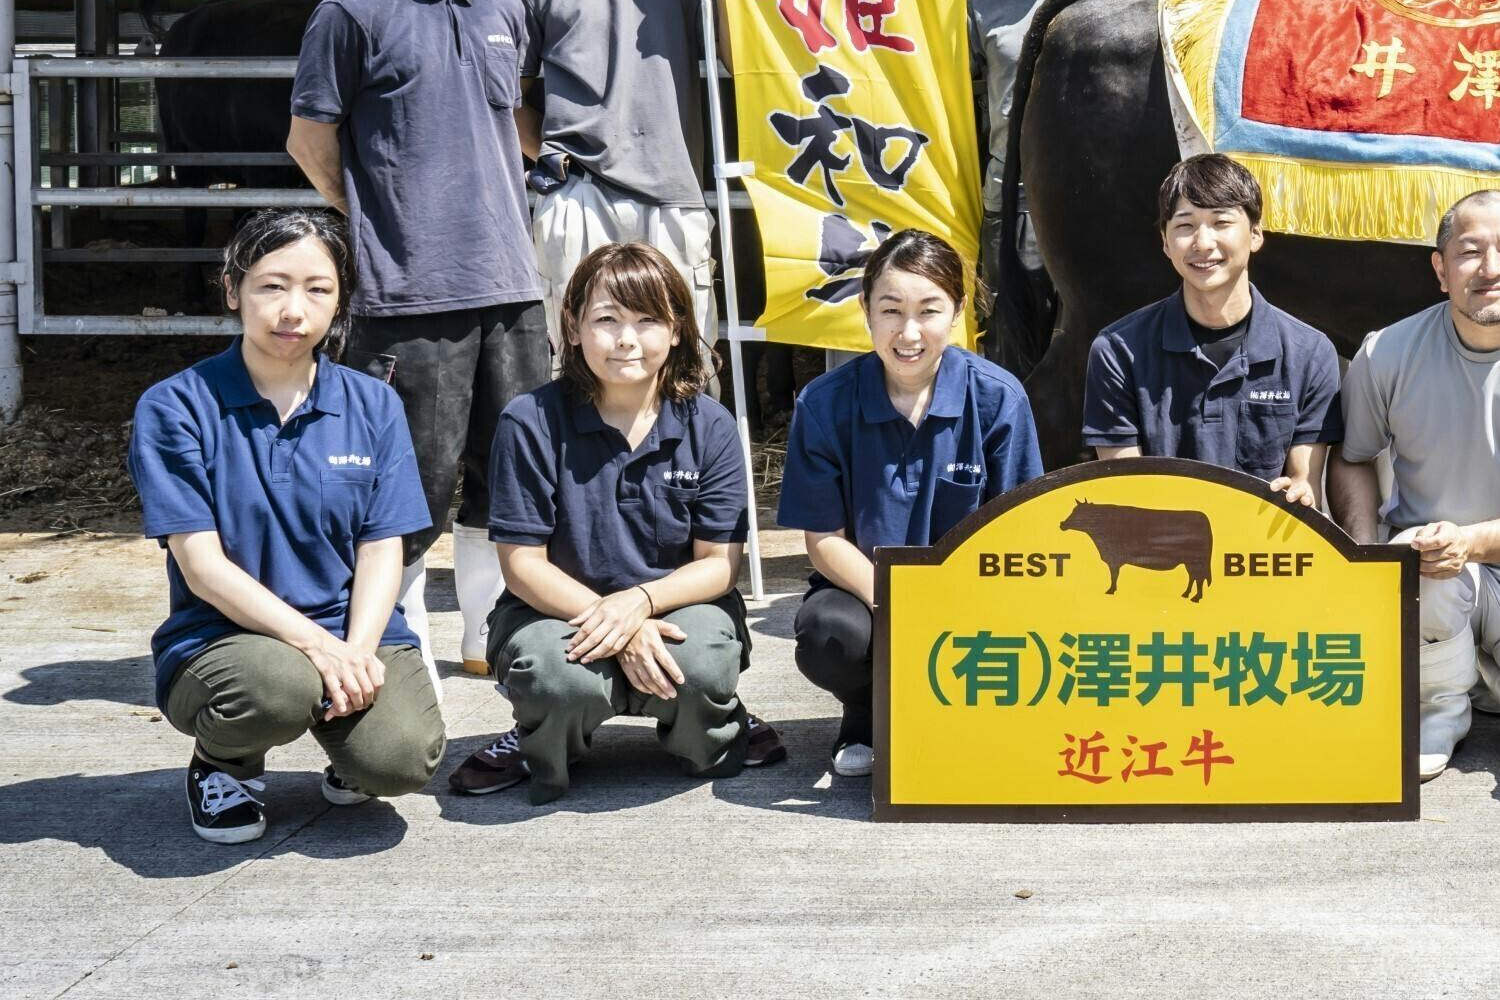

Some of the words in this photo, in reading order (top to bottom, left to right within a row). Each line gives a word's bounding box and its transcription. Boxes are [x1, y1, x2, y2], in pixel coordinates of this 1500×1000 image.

[978, 552, 1071, 577] BEST
[1223, 552, 1314, 577] BEEF
[1057, 729, 1235, 786] 近江牛
